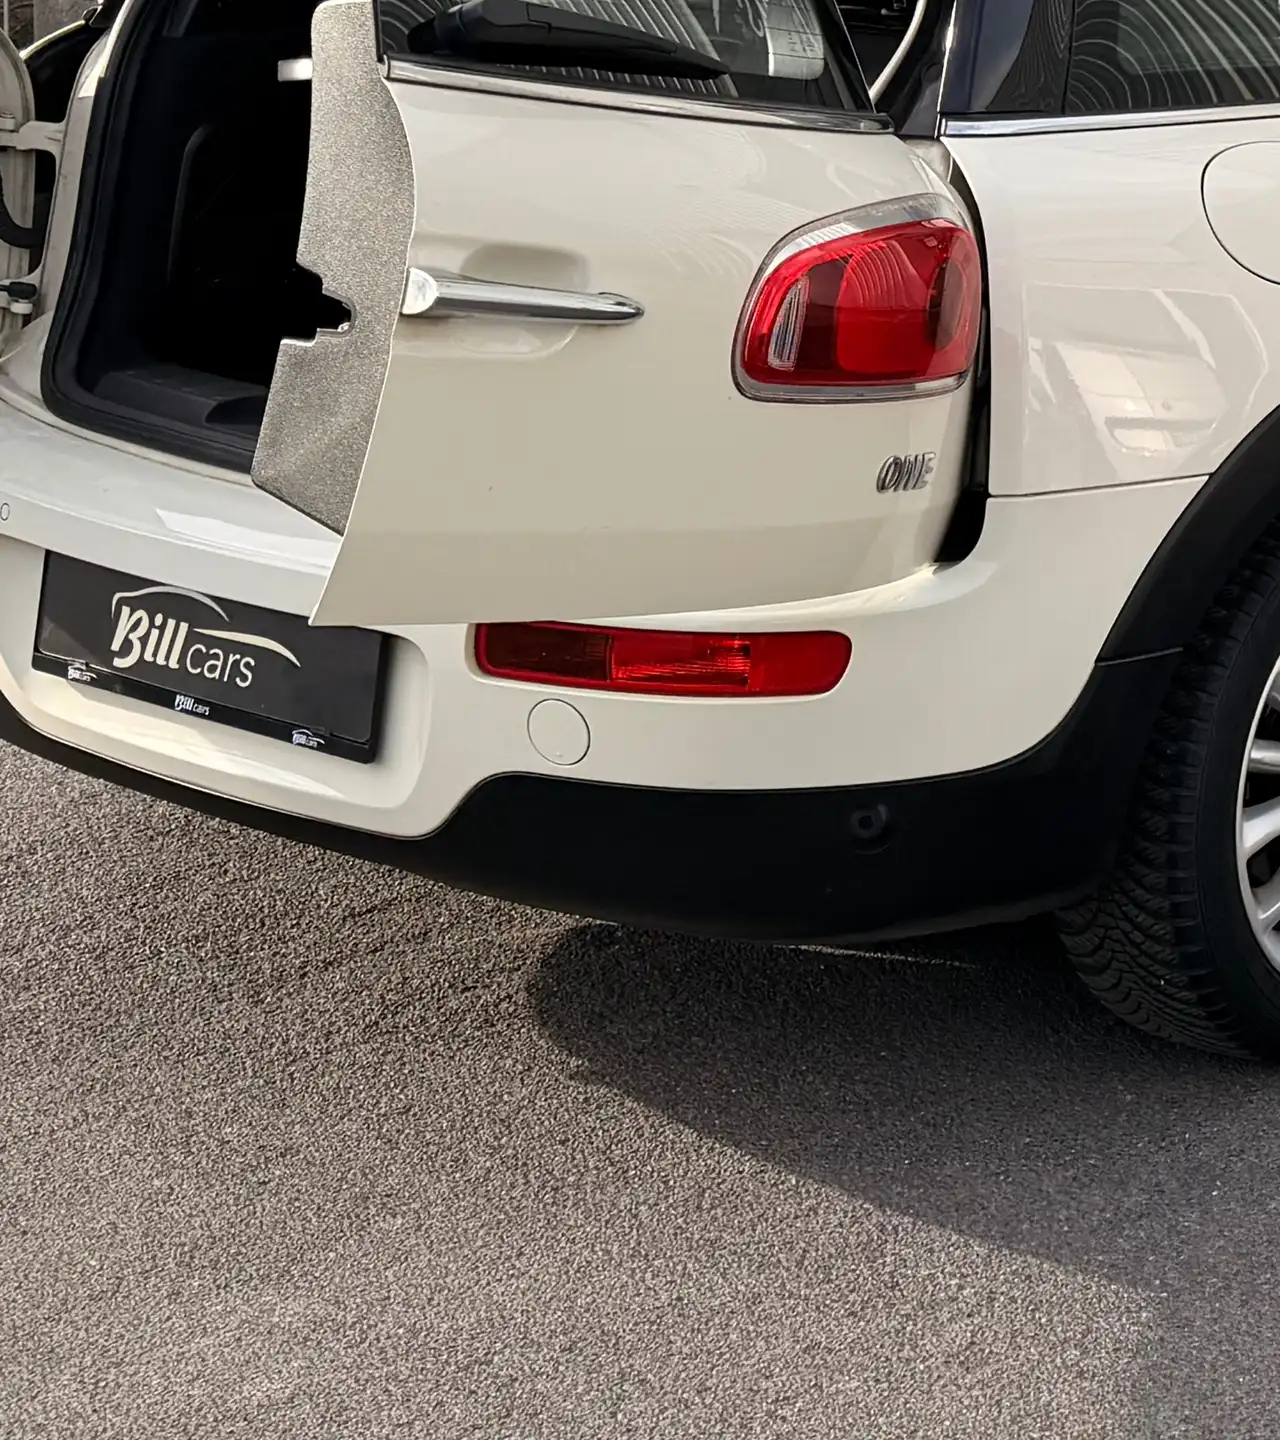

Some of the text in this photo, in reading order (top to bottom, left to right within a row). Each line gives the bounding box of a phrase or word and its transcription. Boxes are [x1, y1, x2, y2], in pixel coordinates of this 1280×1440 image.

[876, 451, 936, 494] ONE
[110, 604, 256, 689] Bill cars
[174, 693, 210, 716] Bill cars
